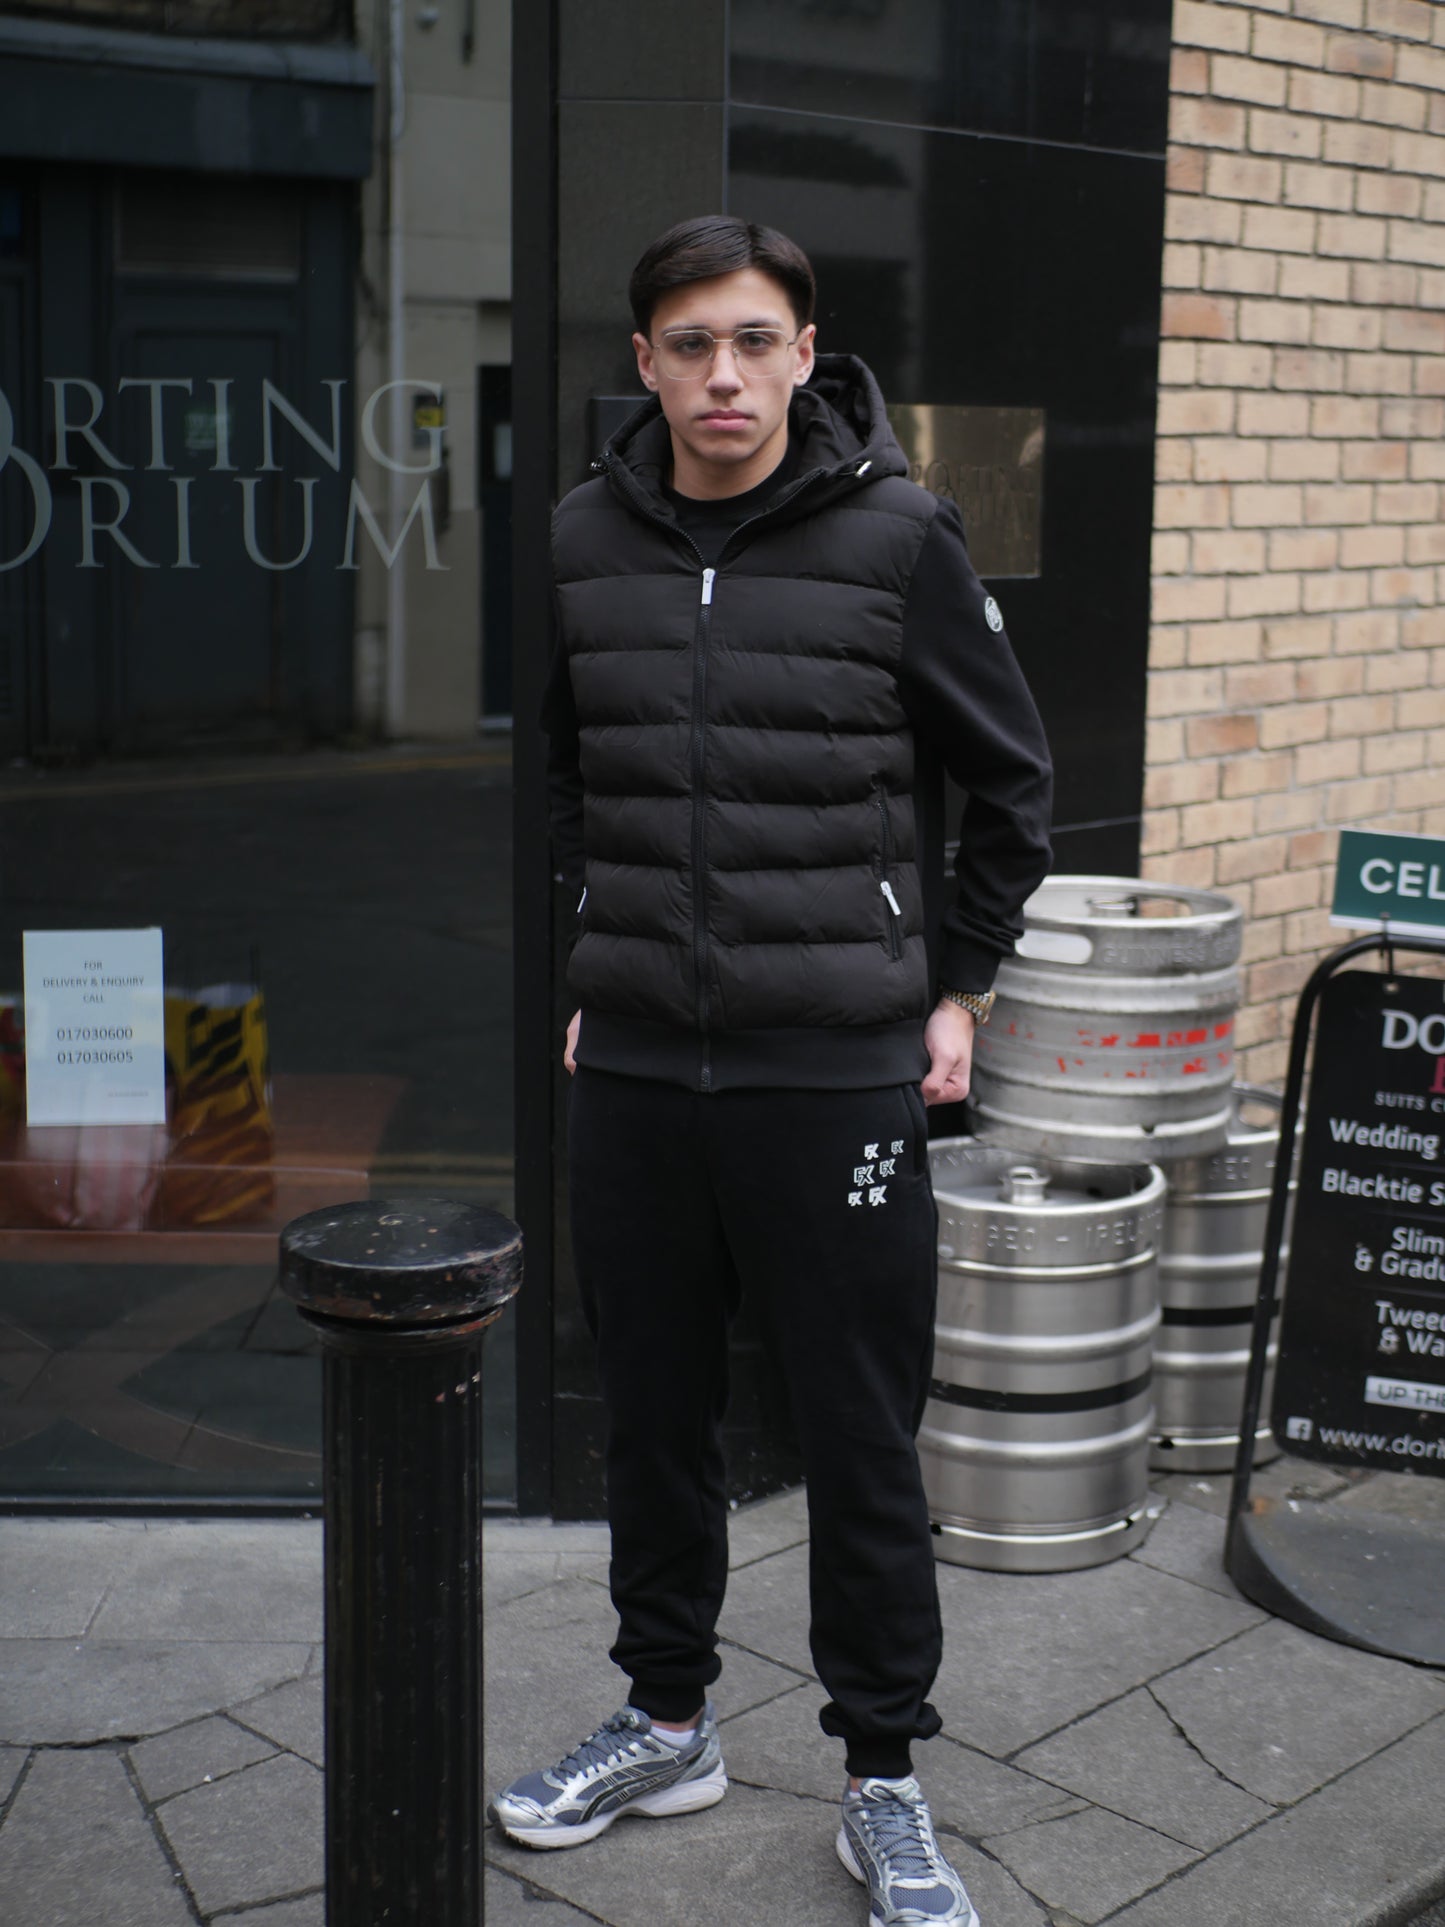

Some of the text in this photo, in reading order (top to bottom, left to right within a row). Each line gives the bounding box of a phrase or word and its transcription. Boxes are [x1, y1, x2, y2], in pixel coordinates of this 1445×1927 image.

[0, 377, 448, 474] RTING
[84, 961, 103, 970] FOR
[43, 976, 145, 988] DELIVERY & ENQUIRY
[83, 995, 105, 1003] CALL
[57, 1028, 133, 1041] 017030600
[1381, 1008, 1445, 1055] DO
[57, 1051, 133, 1064] 017030605
[1374, 1091, 1426, 1111] SUITS
[1329, 1117, 1440, 1160] Wedding
[1322, 1167, 1424, 1204] Blacktie
[1391, 1226, 1445, 1256] Slim
[1354, 1247, 1374, 1272] &
[1379, 1326, 1400, 1353] &
[1377, 1384, 1407, 1402] UP
